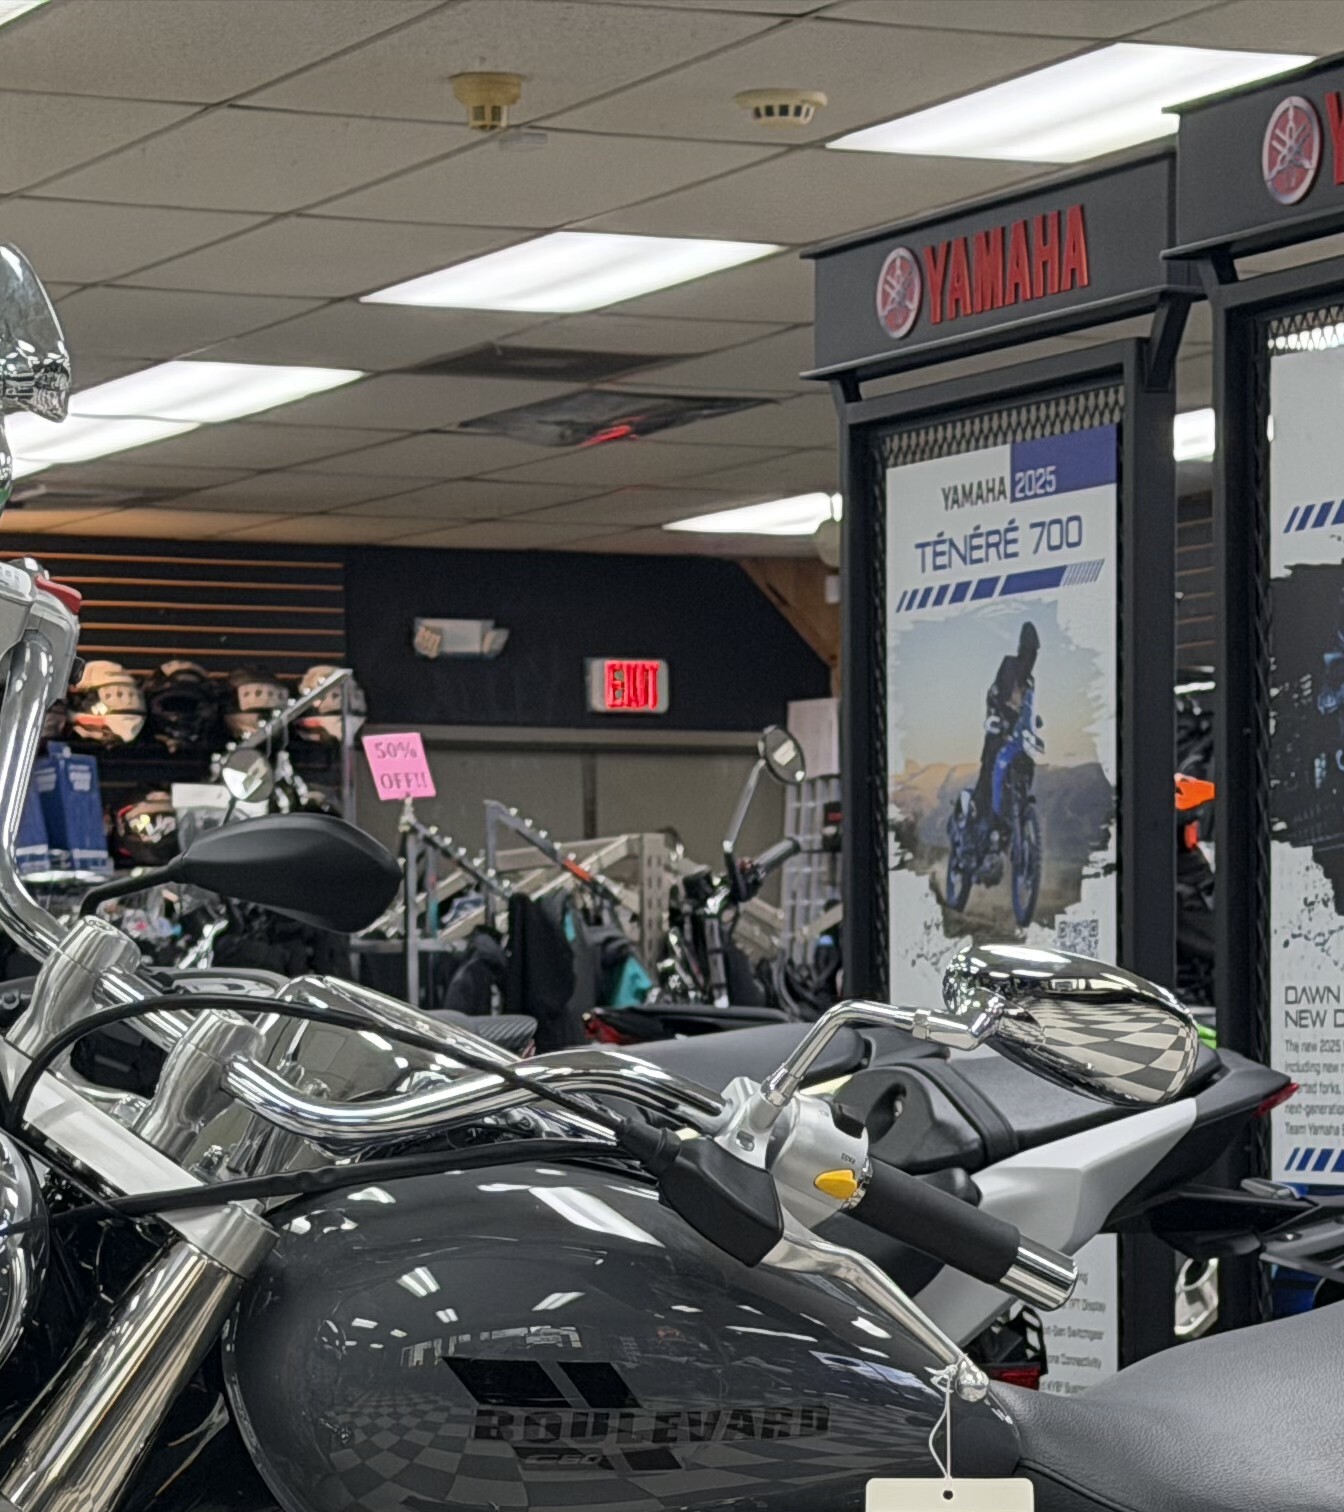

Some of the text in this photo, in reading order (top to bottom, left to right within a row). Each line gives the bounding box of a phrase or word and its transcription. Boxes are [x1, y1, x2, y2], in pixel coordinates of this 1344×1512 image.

[923, 204, 1090, 325] YAMAHA
[941, 466, 1056, 511] YAMAHA 2025
[915, 515, 1082, 573] TÉNÉRÉ 700
[604, 660, 659, 709] EXIT
[374, 741, 417, 759] 50%
[1285, 985, 1340, 1005] DAWN
[1285, 1009, 1329, 1028] NEW
[473, 1405, 831, 1444] BOULEVARD
